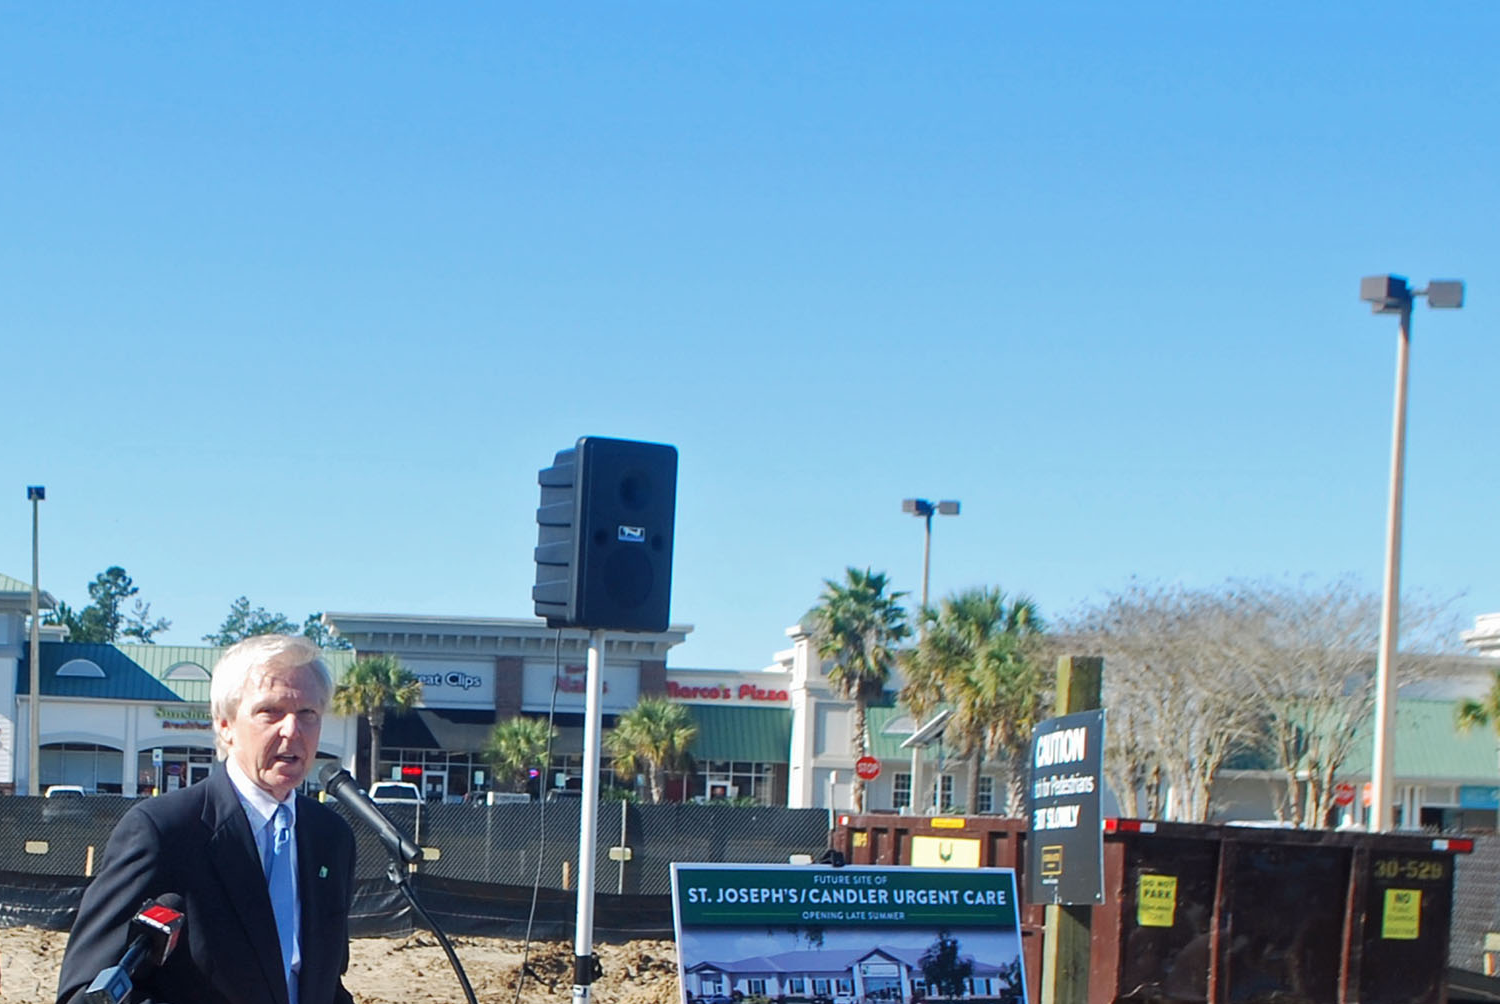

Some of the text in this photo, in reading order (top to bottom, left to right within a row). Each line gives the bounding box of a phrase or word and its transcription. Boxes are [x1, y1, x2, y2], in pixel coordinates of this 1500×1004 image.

[445, 671, 482, 690] Clips
[666, 681, 788, 700] Marco's Pizza
[1035, 727, 1087, 768] CAUTION
[858, 762, 878, 773] STOP
[1051, 772, 1095, 796] Pedestrians
[814, 876, 887, 884] FUTURE SITE OF
[688, 888, 712, 903] ST.
[893, 890, 959, 905] URGENT
[963, 890, 1007, 905] CARE
[1143, 889, 1172, 898] PARK
[802, 911, 905, 920] OPENING LATE SUMMER
